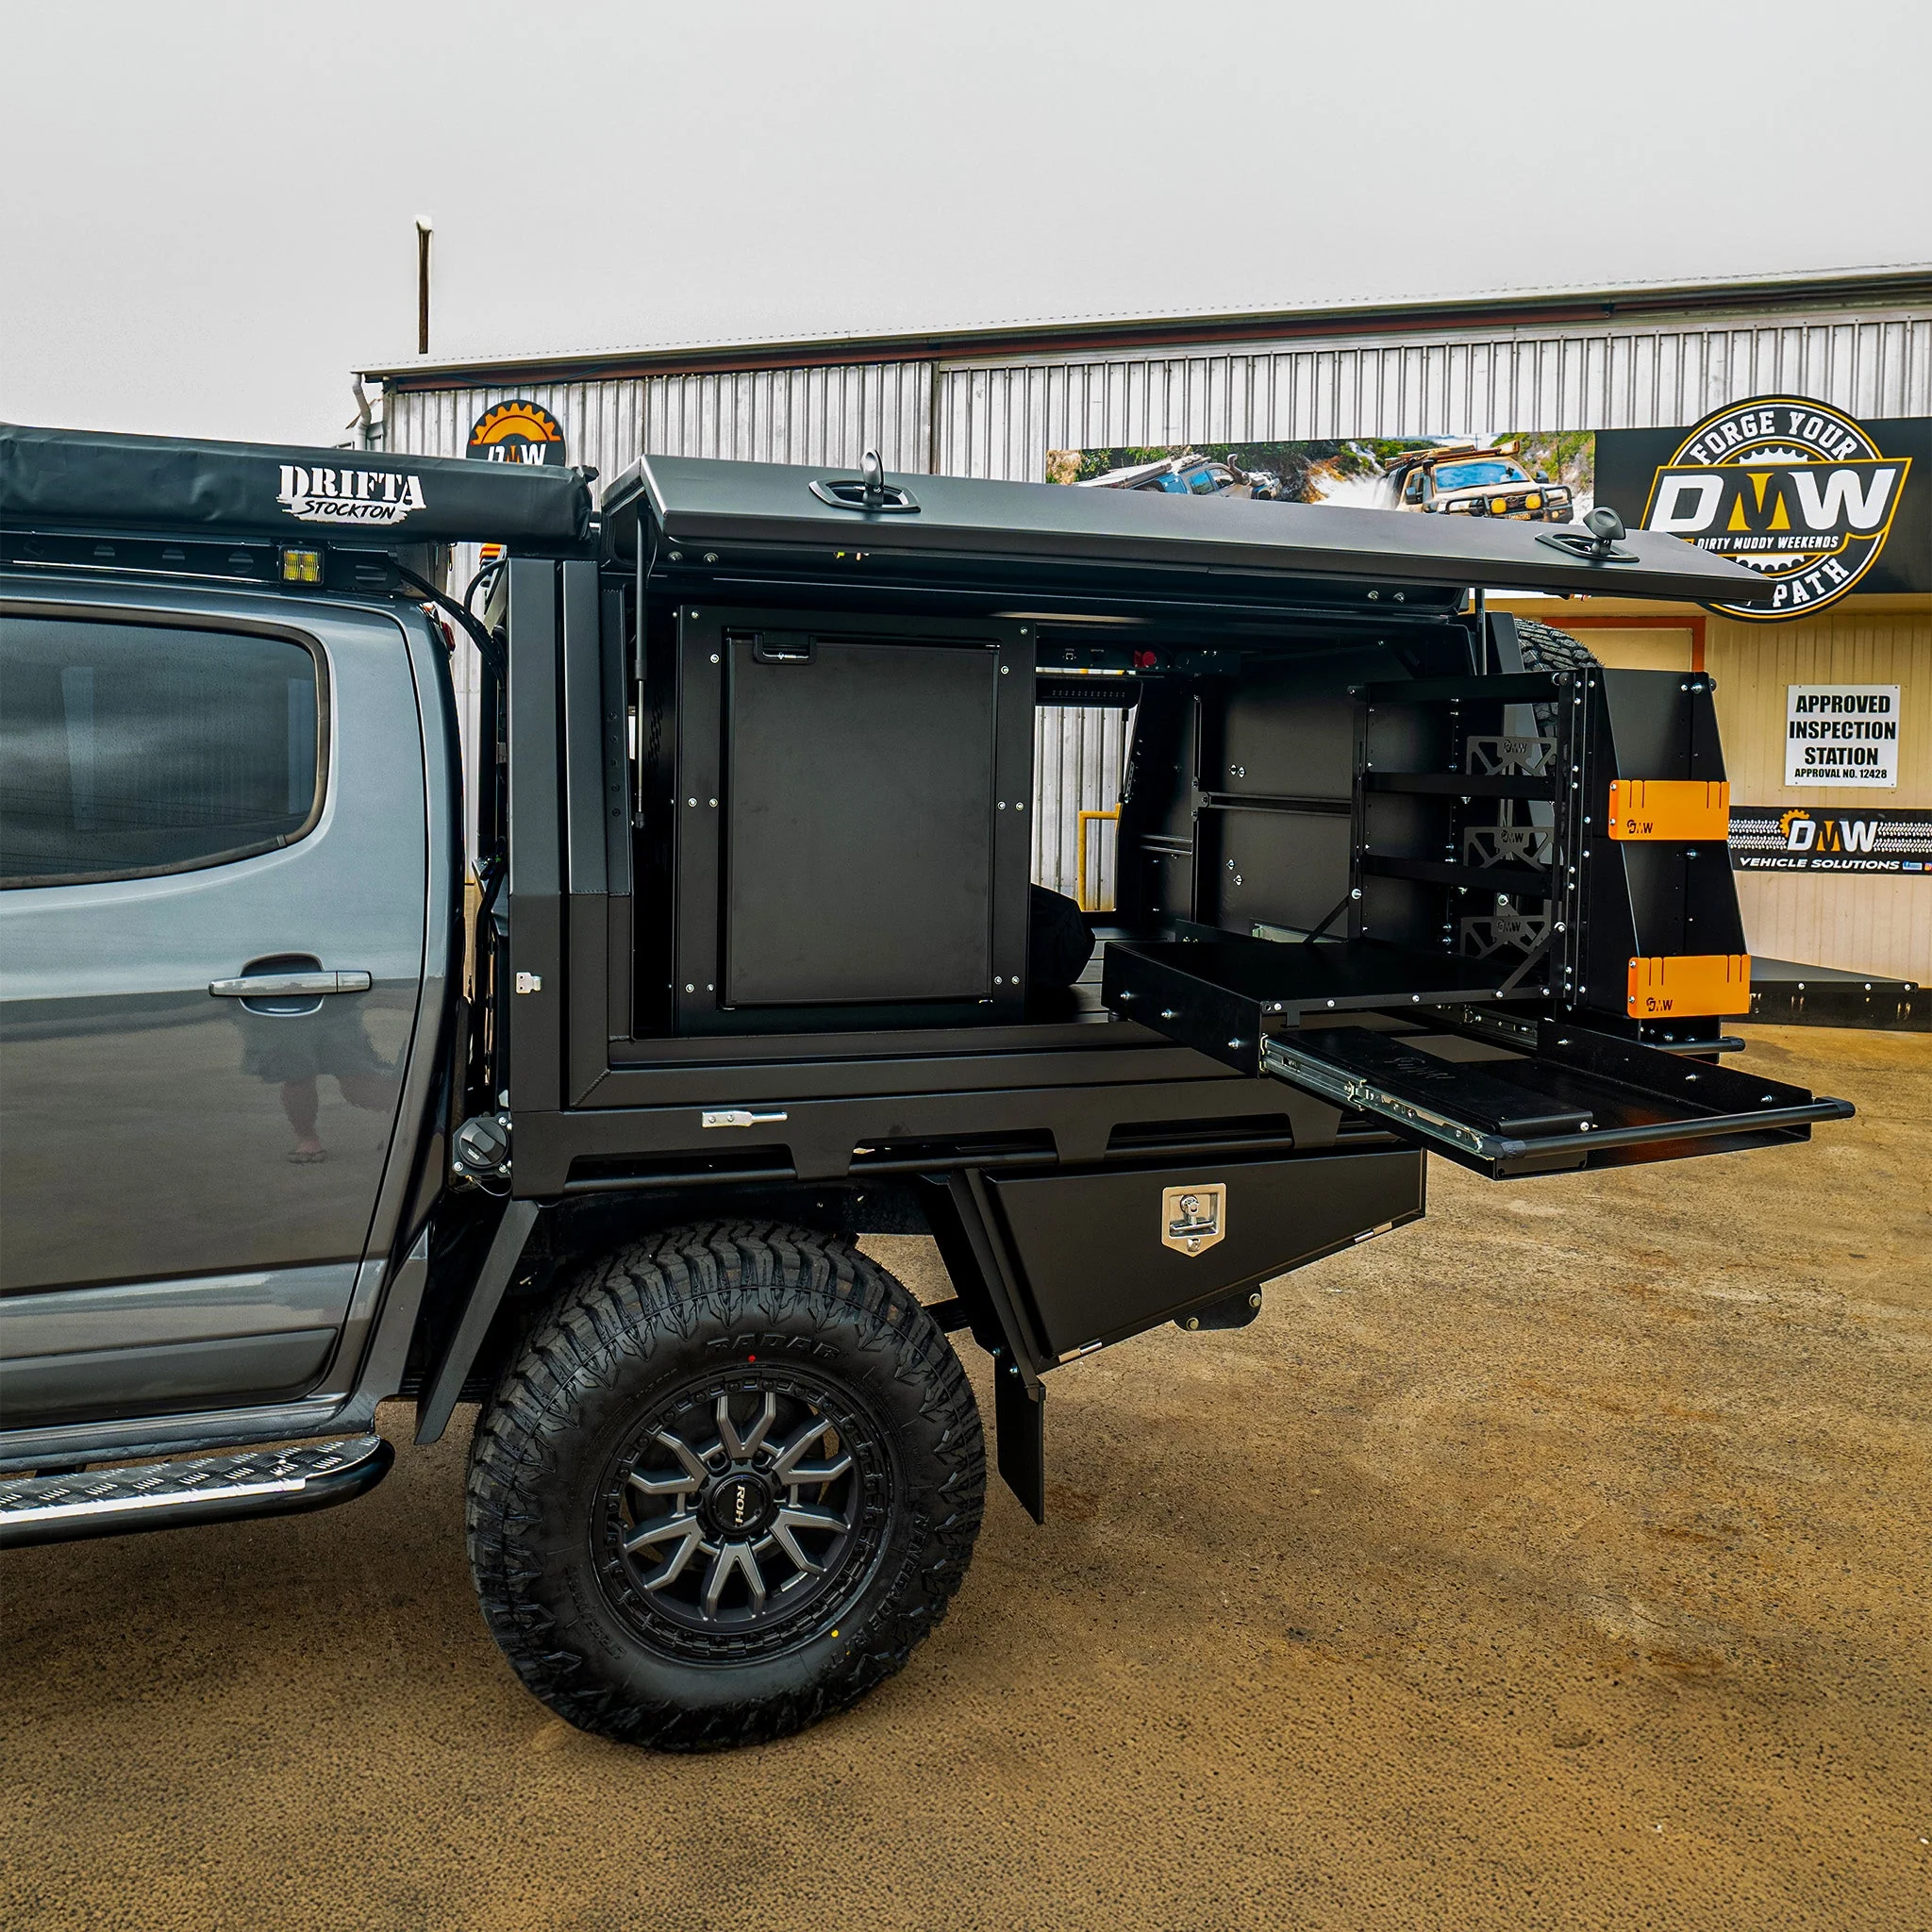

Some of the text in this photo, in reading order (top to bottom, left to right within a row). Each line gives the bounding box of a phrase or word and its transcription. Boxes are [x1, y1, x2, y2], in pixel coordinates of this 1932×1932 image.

[1690, 410, 1858, 465] FORGE YOUR
[278, 464, 426, 509] DRIFTA
[297, 500, 396, 519] STOCKTON
[1649, 468, 1897, 532] DMW
[1697, 535, 1839, 550] DIRTY MUDDY WEEKENDS
[1772, 558, 1850, 608] PATH
[1795, 695, 1891, 713] APPROVED
[1789, 721, 1896, 740] INSPECTION
[1804, 747, 1879, 766] STATION
[1794, 768, 1888, 779] APPROVAL NO. 12428
[1787, 820, 1879, 853] DMW
[1740, 857, 1807, 869] VEHICLE
[1810, 858, 1900, 870] SOLUTIONS
[735, 1485, 746, 1524] ROH
